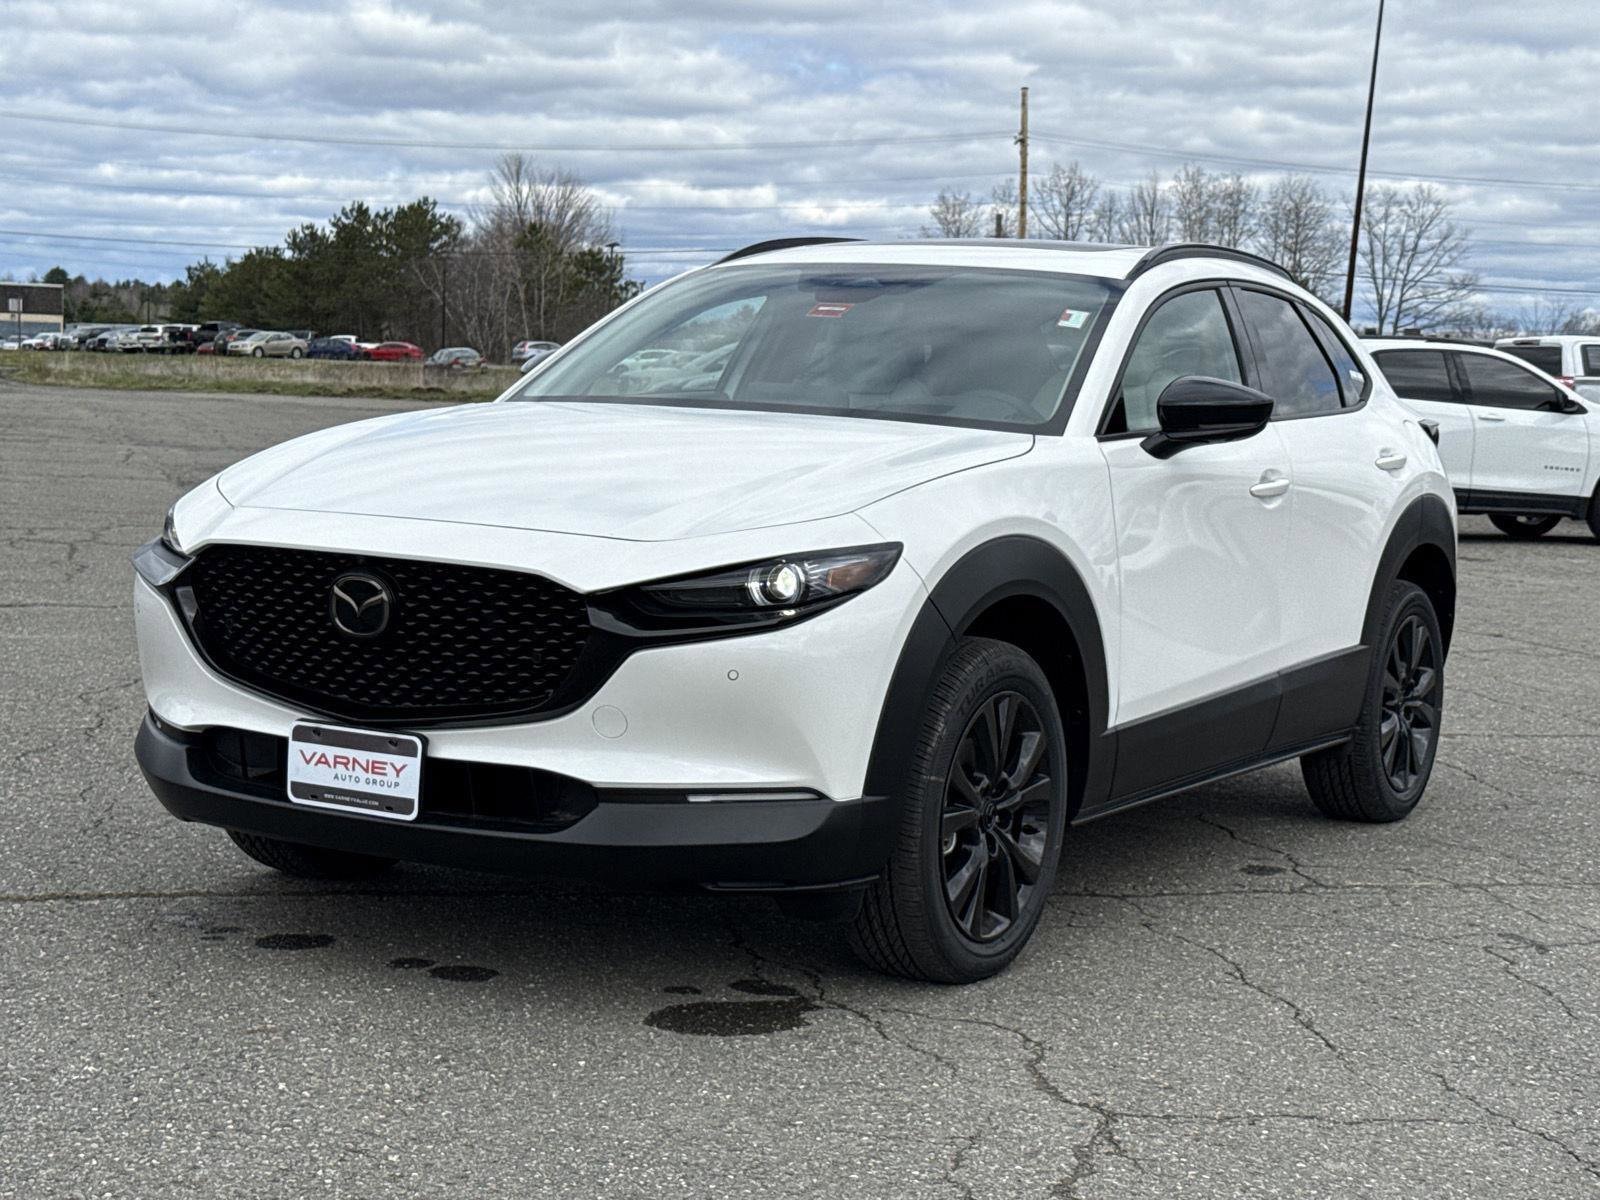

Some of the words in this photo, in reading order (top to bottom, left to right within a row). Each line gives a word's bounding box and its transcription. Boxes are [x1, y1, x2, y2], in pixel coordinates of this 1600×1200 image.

[299, 749, 408, 778] VARNEY
[333, 773, 361, 784] AUTO
[365, 777, 400, 789] GROUP
